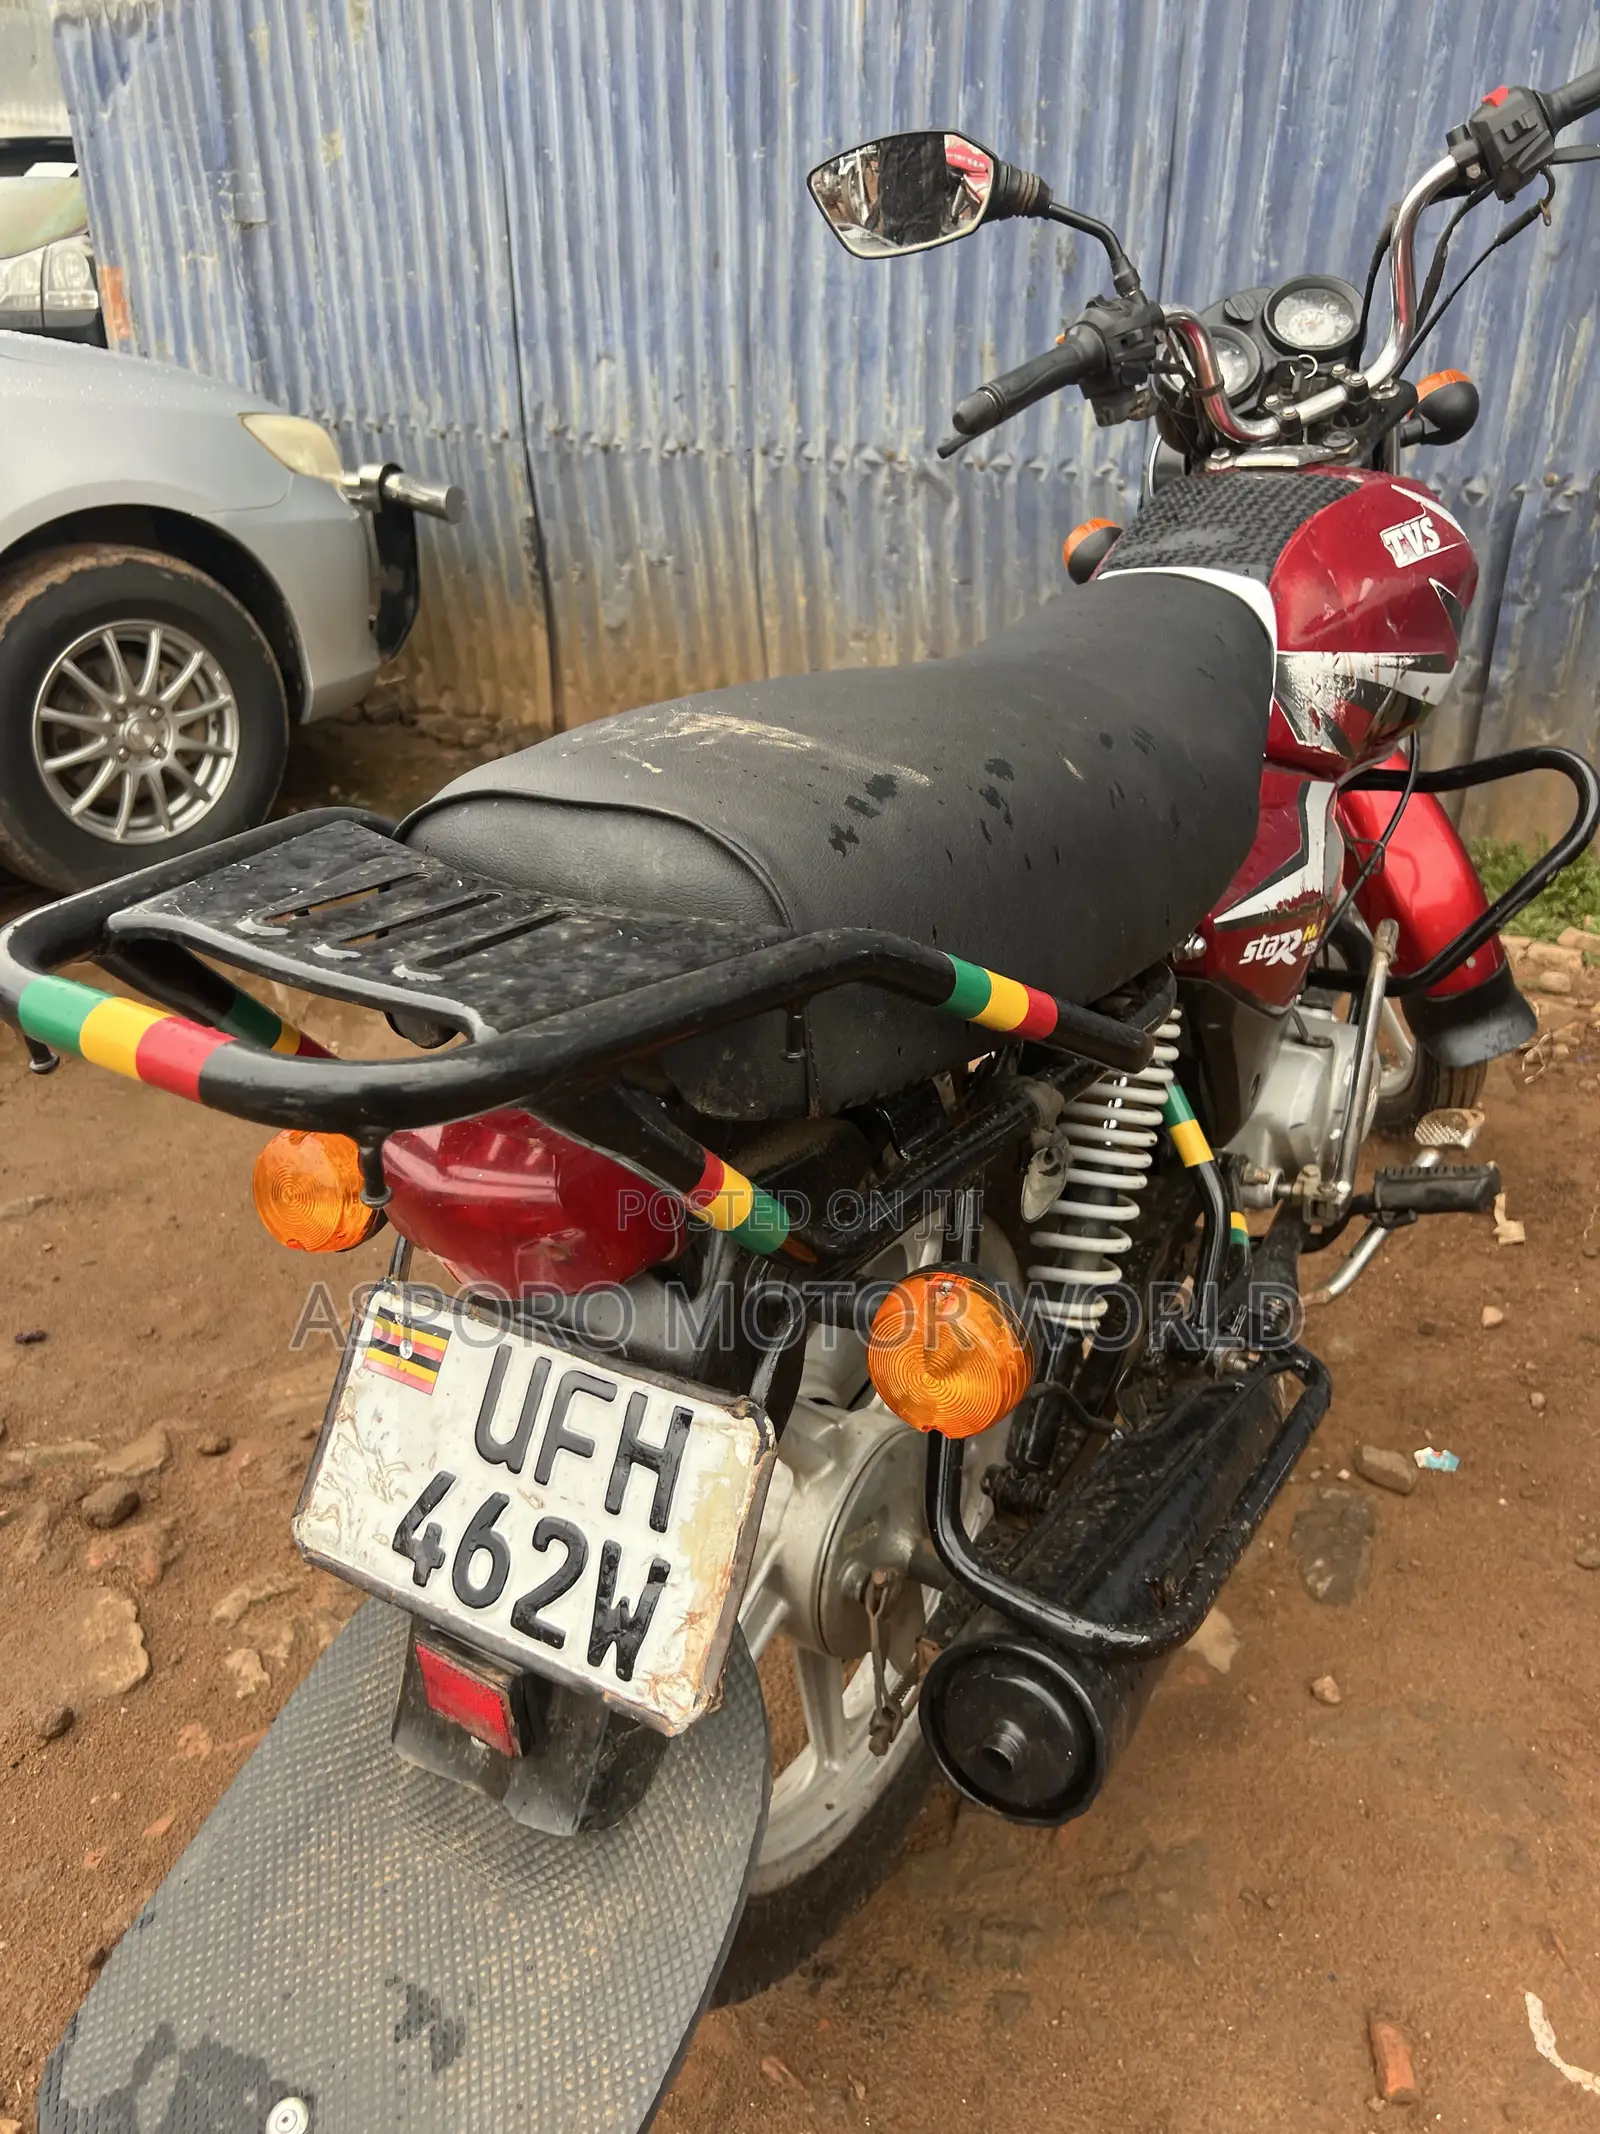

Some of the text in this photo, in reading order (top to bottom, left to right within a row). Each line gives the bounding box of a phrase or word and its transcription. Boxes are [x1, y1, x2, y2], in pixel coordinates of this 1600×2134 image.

[1382, 516, 1441, 564] TVS
[474, 1343, 695, 1534] UFH
[391, 1469, 672, 1683] 462W
